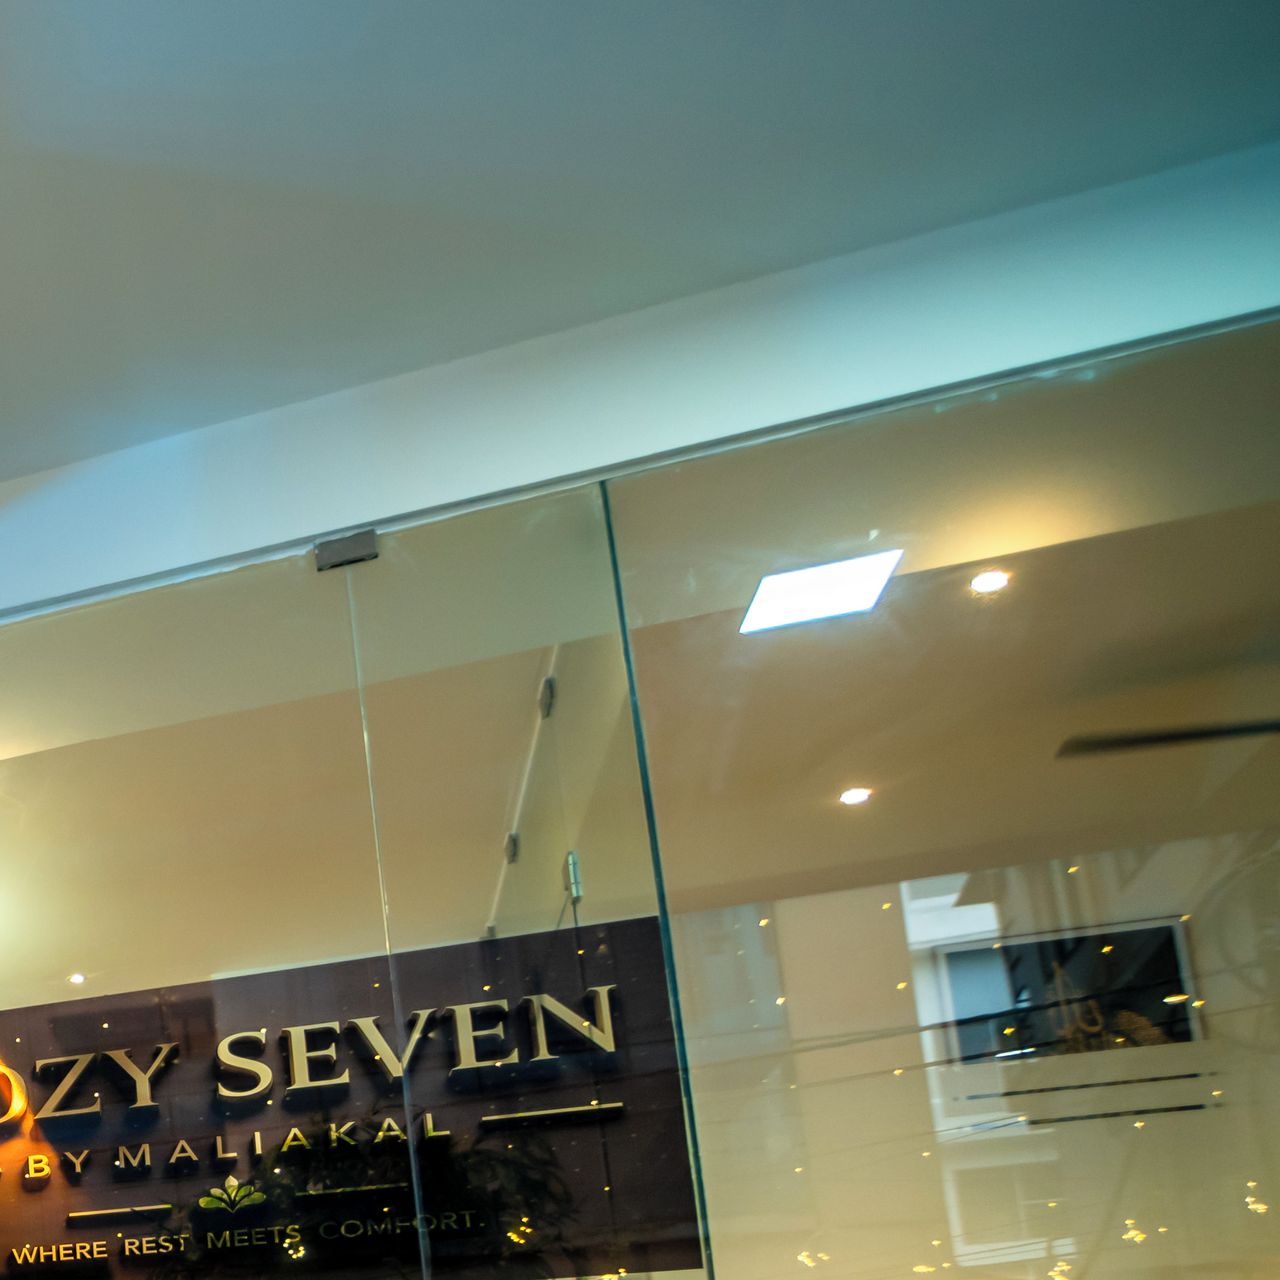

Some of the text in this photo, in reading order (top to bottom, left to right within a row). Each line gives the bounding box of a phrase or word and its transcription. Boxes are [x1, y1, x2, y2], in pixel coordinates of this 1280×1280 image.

[214, 984, 618, 1101] SEVEN
[27, 1111, 452, 1180] BY MALIAKAL
[11, 1240, 109, 1266] WHERE
[123, 1233, 191, 1258] REST
[206, 1223, 302, 1250] MEETS
